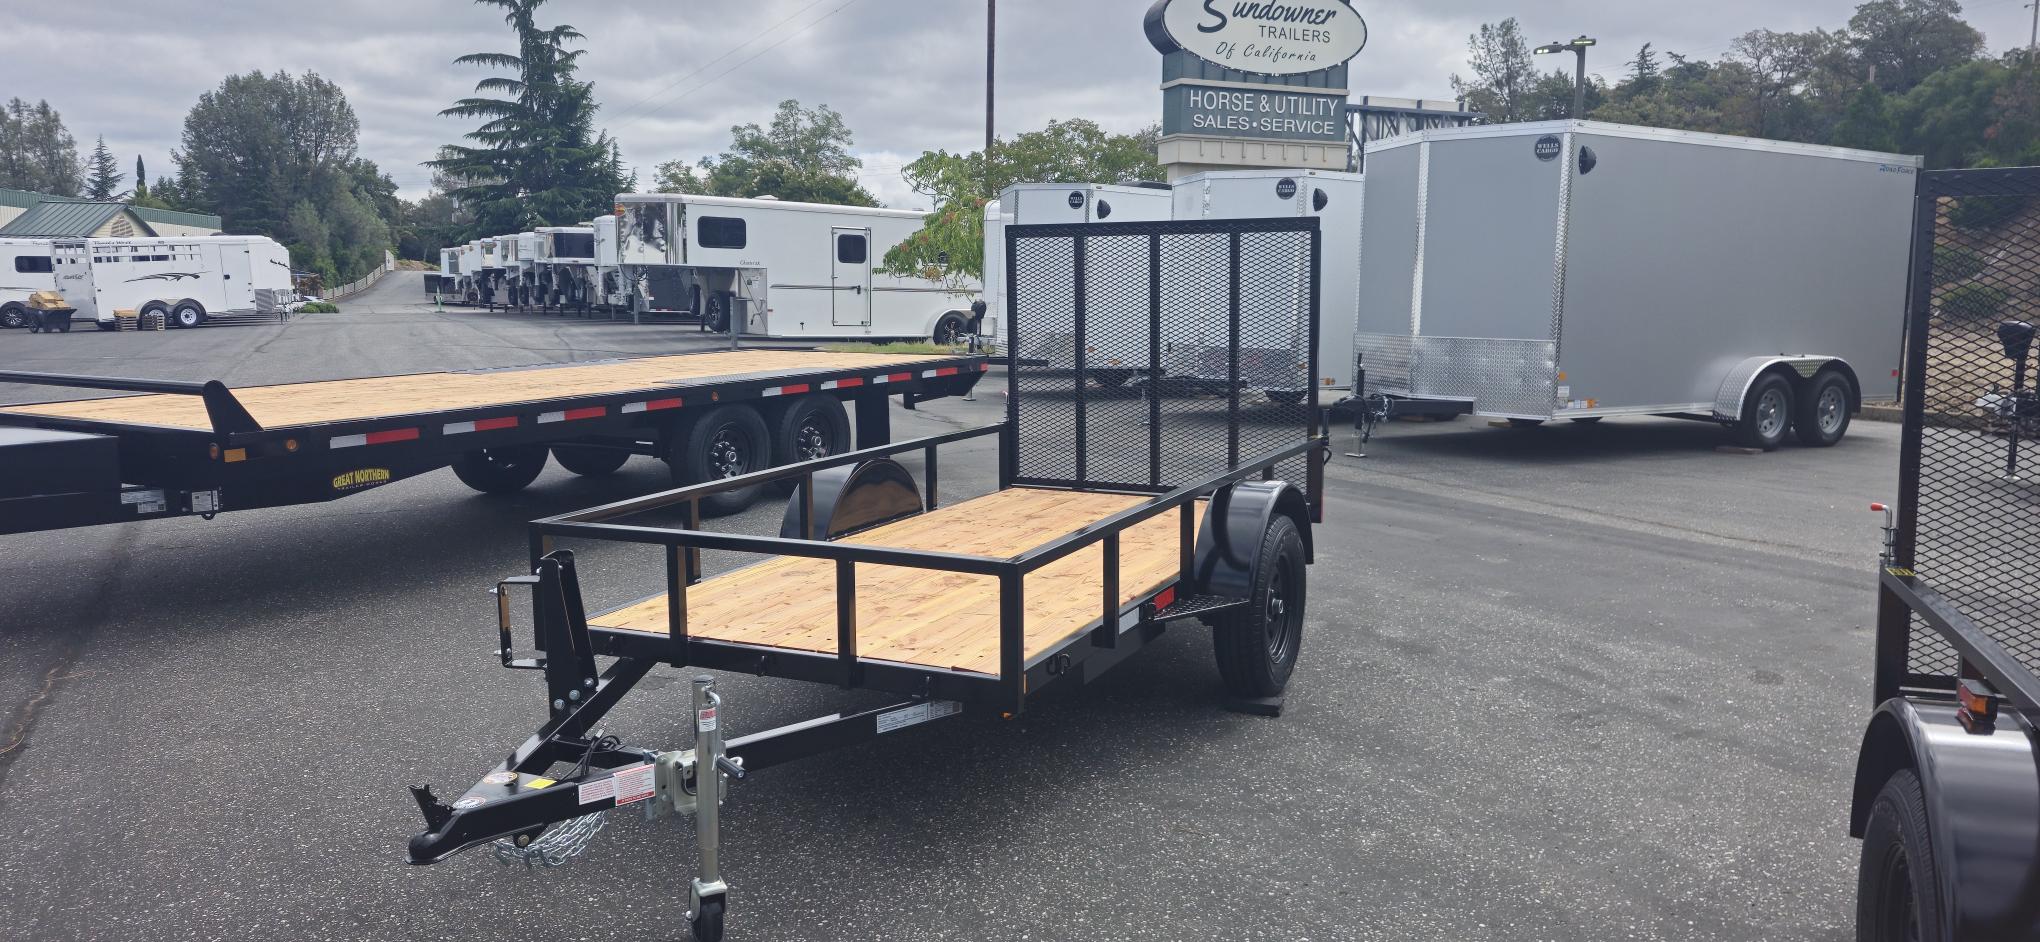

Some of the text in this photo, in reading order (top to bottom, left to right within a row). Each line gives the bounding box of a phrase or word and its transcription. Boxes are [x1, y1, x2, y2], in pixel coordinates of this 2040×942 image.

[1197, 0, 1337, 33] Sundowner
[1258, 25, 1331, 43] TRAILERS
[1215, 41, 1316, 62] Of California
[1189, 90, 1338, 116] HORSE & UTILITY
[333, 468, 390, 488] GREAT NORTHERN
